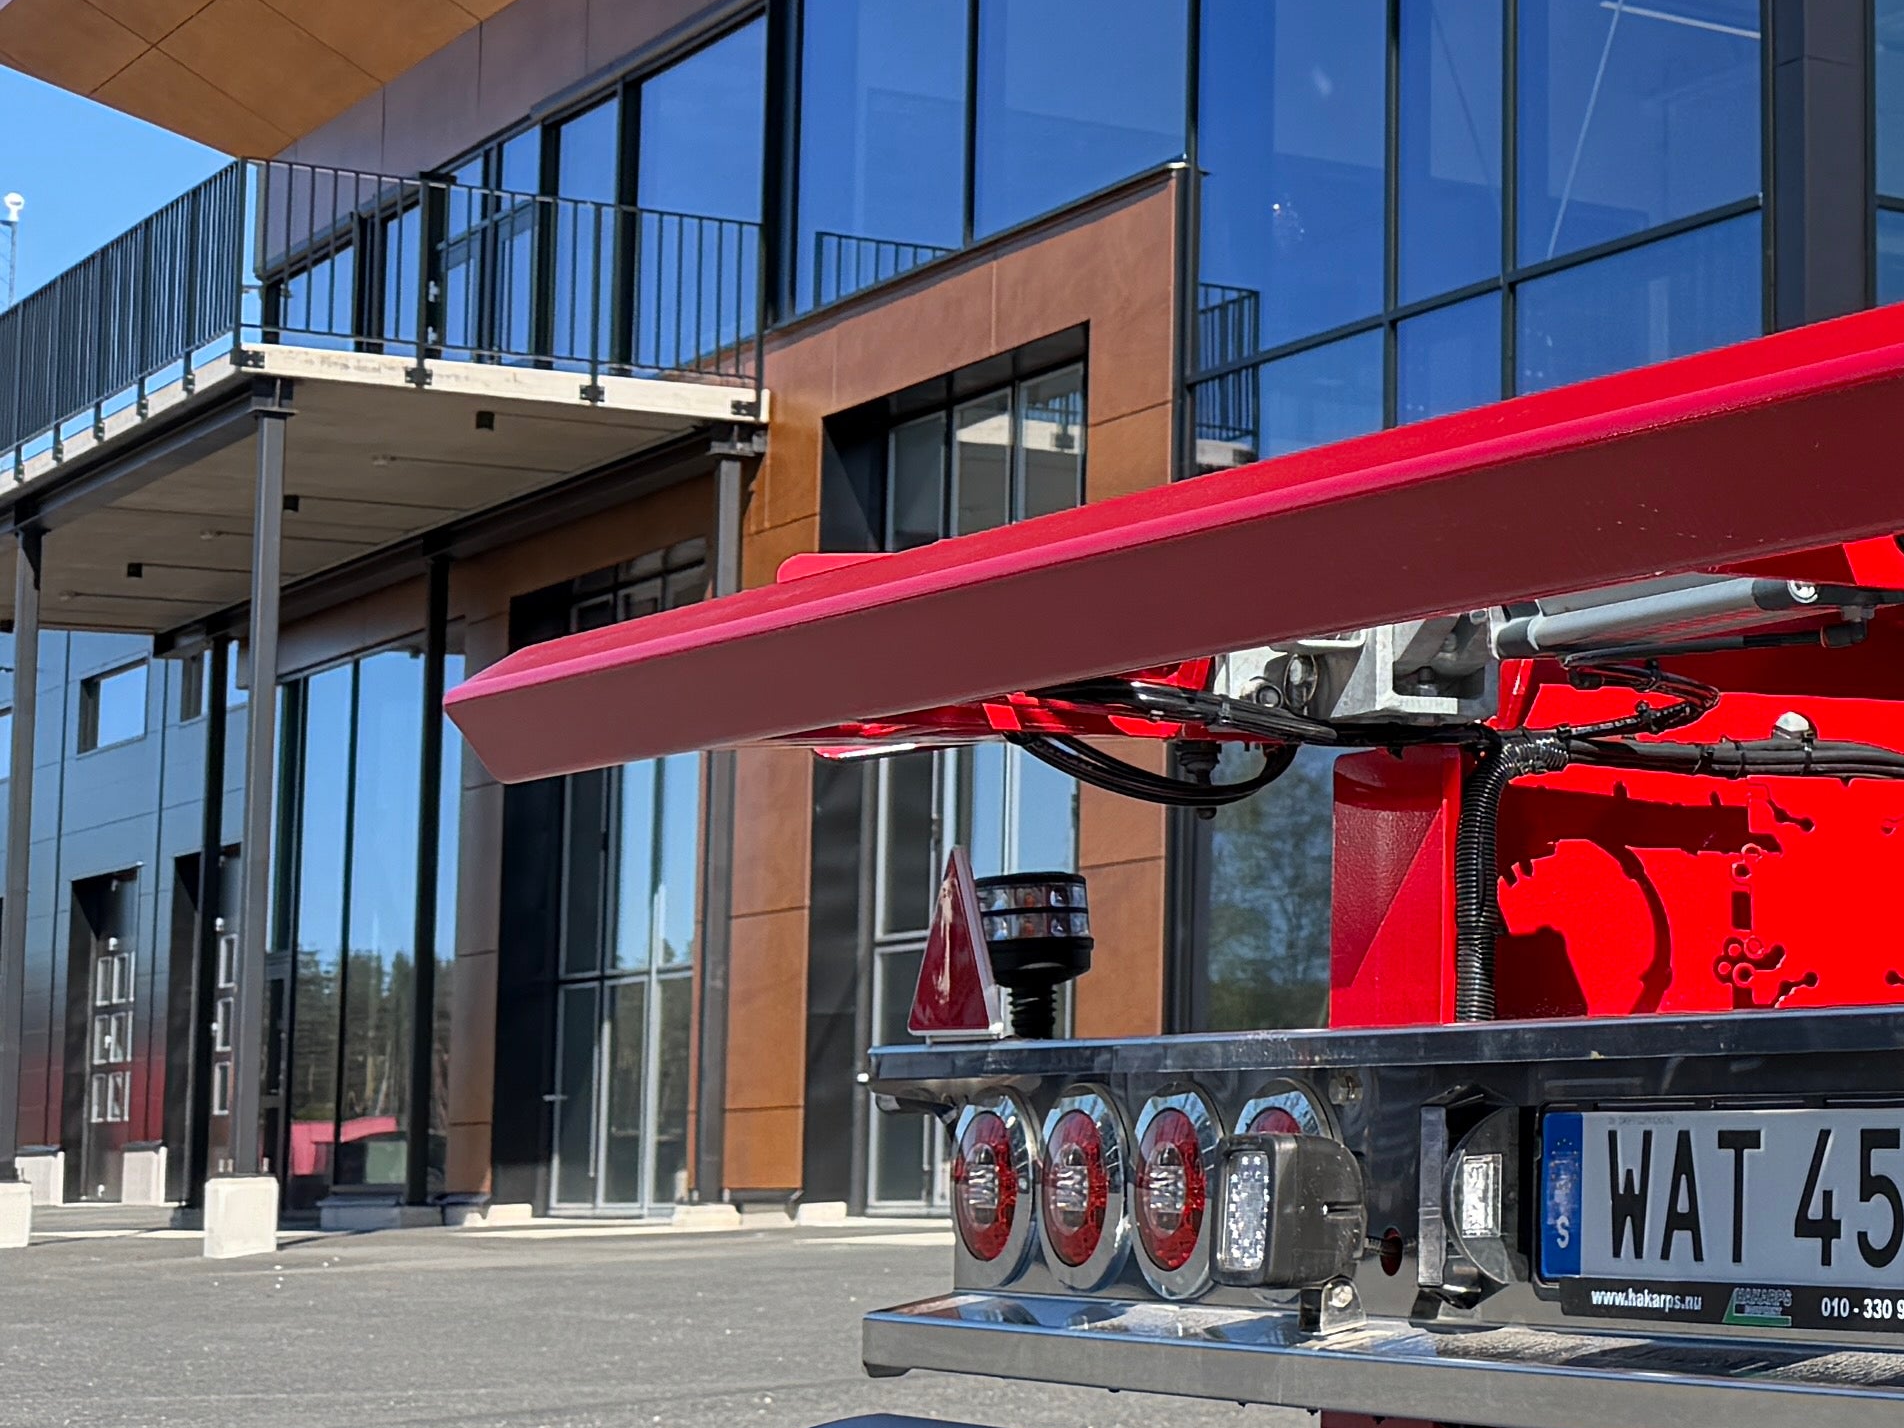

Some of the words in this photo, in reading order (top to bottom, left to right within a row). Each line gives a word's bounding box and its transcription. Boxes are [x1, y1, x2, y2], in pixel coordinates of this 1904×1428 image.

[1608, 1129, 1762, 1263] WAT
[1556, 1217, 1570, 1249] S
[1591, 1288, 1702, 1312] www.hakarps.nu
[1821, 1296, 1849, 1317] 010
[1863, 1299, 1892, 1320] 330
